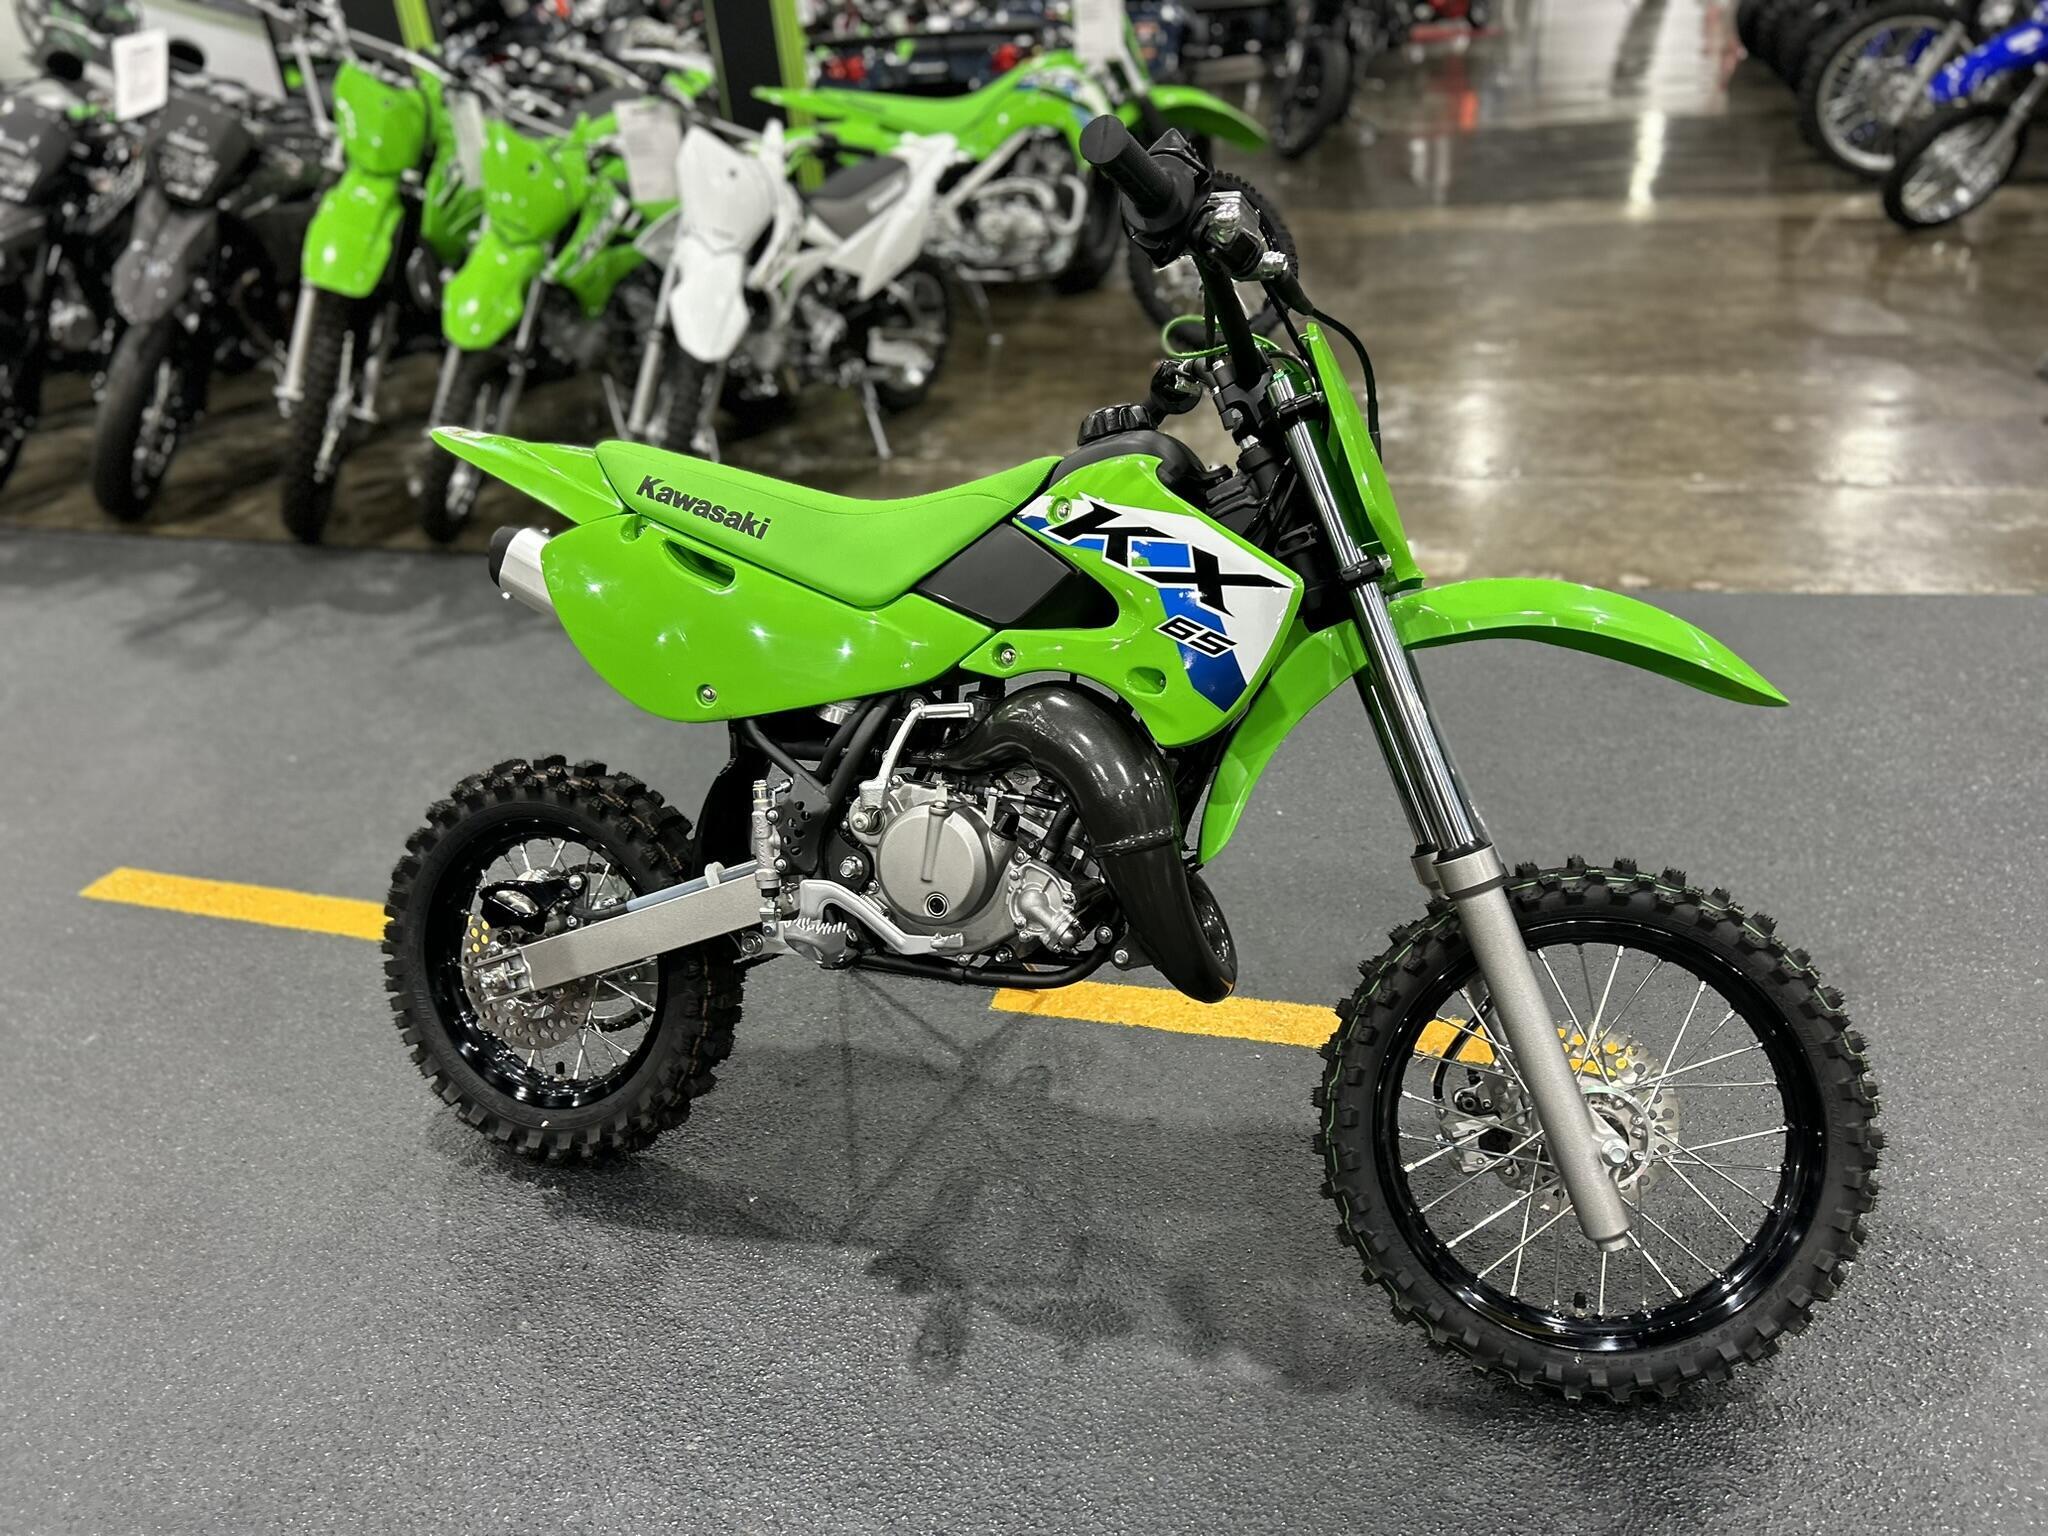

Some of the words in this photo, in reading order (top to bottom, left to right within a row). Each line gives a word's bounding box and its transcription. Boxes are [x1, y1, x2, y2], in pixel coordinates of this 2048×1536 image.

[635, 475, 772, 540] Kawasaki
[1045, 500, 1292, 618] KX
[1156, 615, 1239, 656] 65
